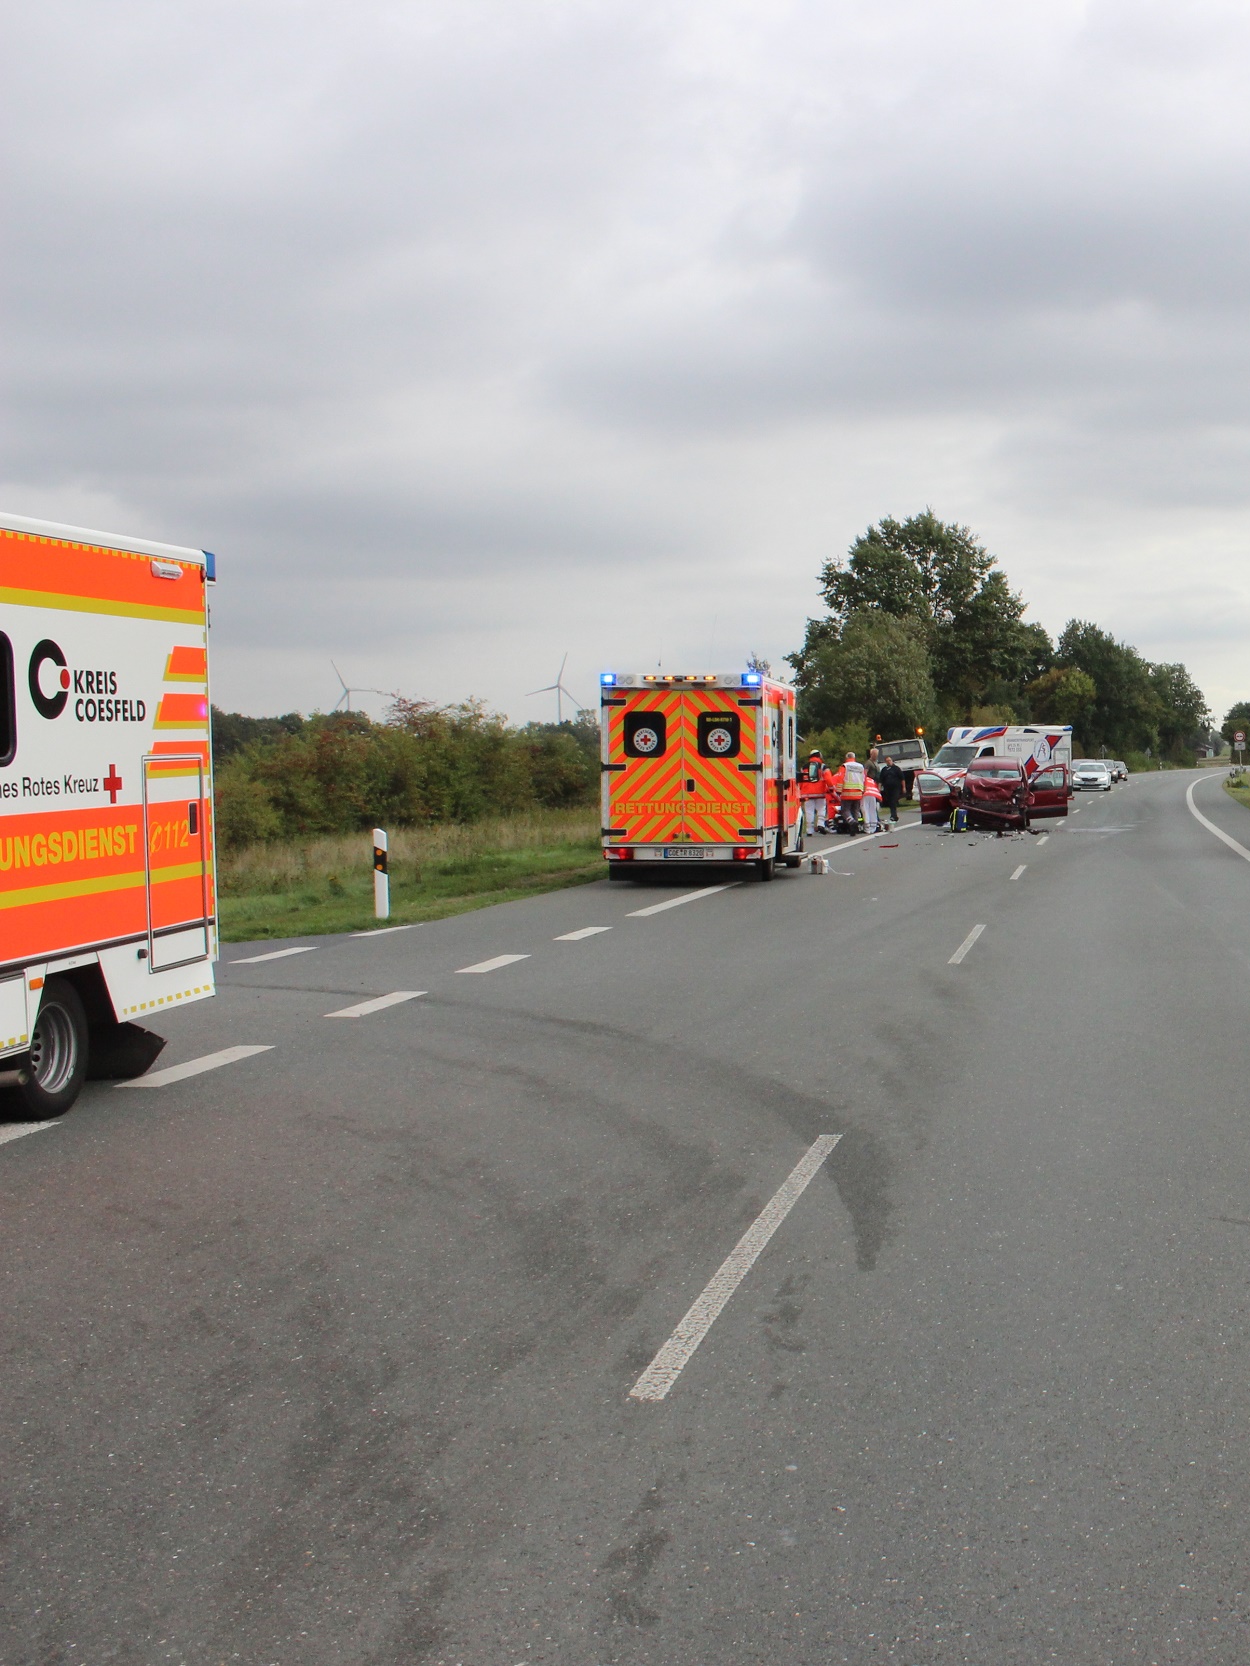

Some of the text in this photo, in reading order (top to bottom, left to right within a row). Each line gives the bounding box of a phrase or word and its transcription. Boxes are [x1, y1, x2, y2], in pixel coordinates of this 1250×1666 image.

[74, 669, 118, 695] KREIS
[75, 698, 146, 722] COESFELD
[22, 776, 60, 797] Rotes
[64, 774, 99, 794] Kreuz
[615, 803, 750, 814] RETTUNGSDIENST
[0, 819, 189, 871] UNGSDIENST 112
